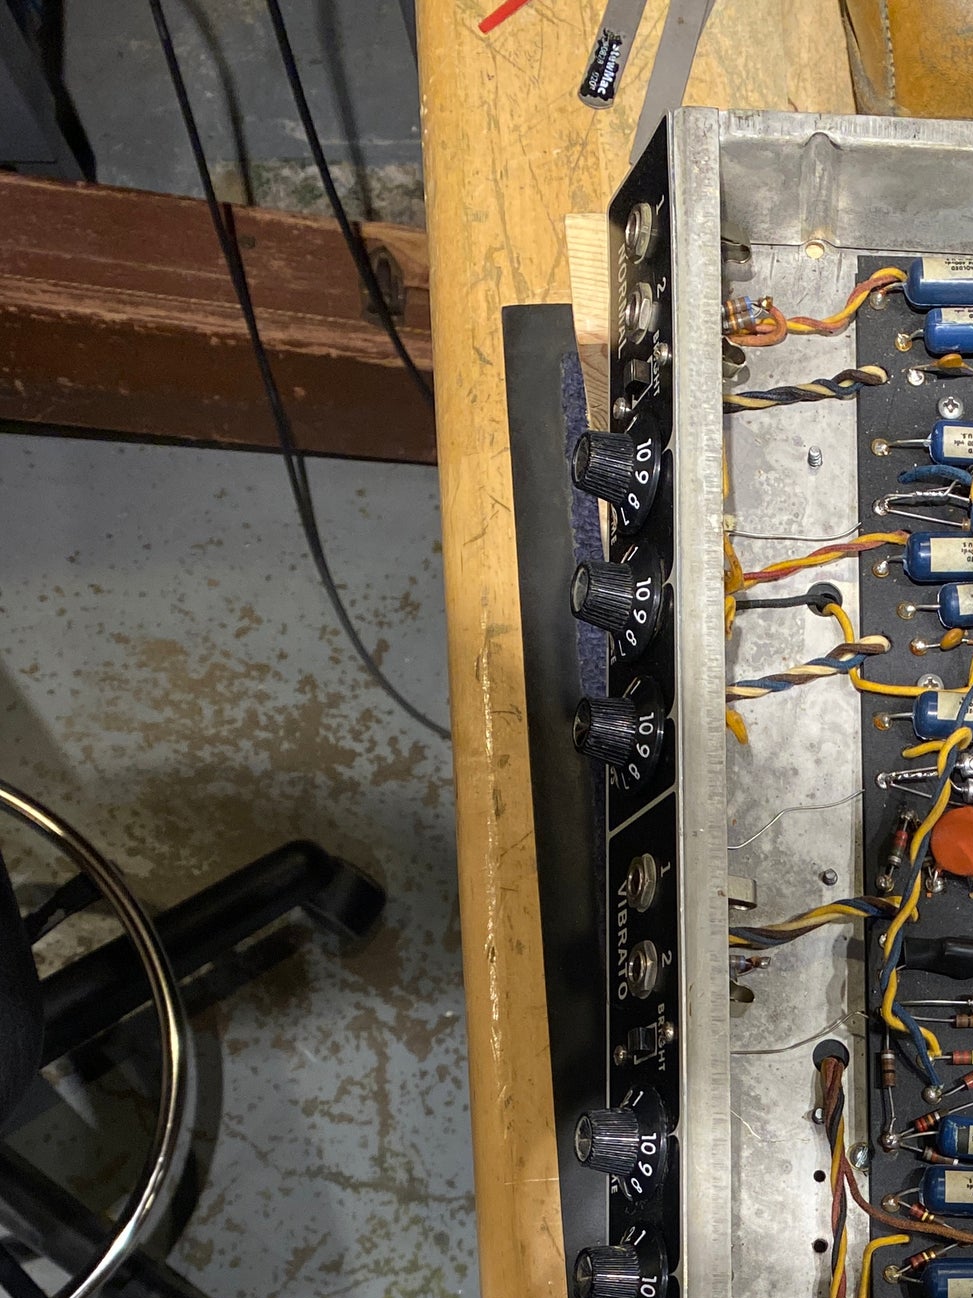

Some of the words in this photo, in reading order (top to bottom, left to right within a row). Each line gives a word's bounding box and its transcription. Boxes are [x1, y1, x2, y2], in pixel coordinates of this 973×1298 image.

[655, 195, 665, 216] 1
[656, 276, 667, 299] 2
[617, 243, 628, 360] NORMAL
[652, 330, 661, 398] BRGHT
[636, 438, 652, 461] 10
[635, 470, 649, 484] 9
[628, 493, 640, 510] 8
[635, 577, 652, 601] 10
[633, 609, 647, 624] 9
[625, 630, 637, 647] 8
[638, 712, 654, 735] 10
[636, 743, 650, 758] 9
[628, 764, 641, 780] 8
[660, 861, 671, 878] 1
[617, 880, 628, 1001] VIBRATO
[661, 950, 672, 968] 2
[640, 1132, 656, 1156] 10
[638, 1161, 652, 1177] 9
[630, 1178, 642, 1194] 8
[640, 1276, 657, 1298] 10
